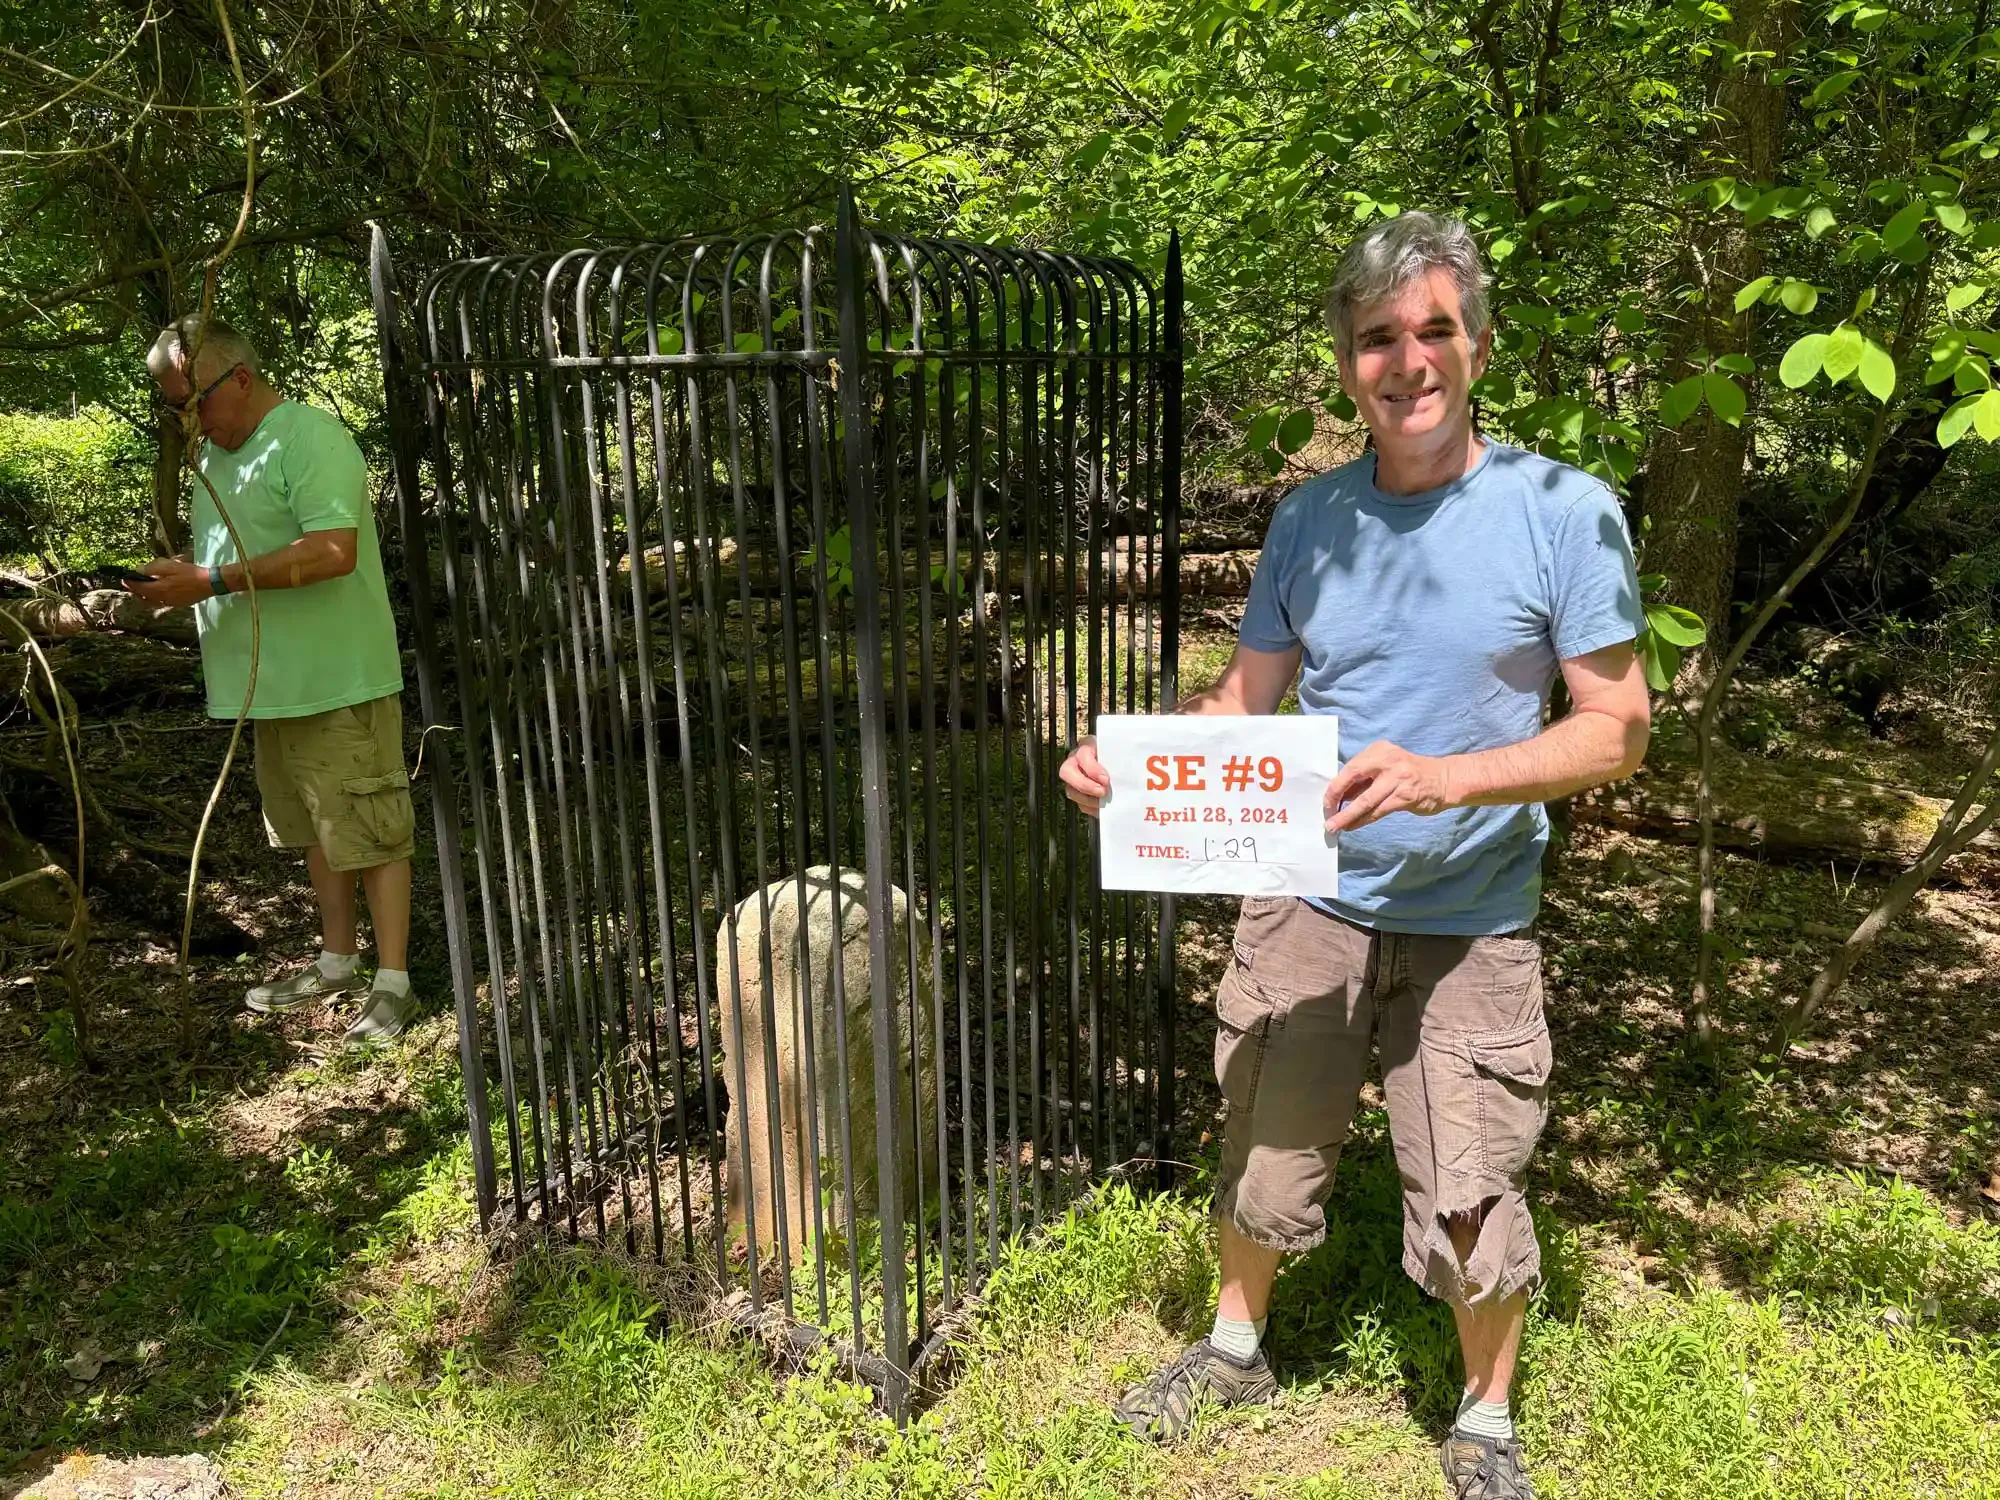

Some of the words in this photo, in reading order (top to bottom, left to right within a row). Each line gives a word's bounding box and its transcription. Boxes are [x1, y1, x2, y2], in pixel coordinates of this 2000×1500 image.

[1146, 755, 1206, 791] SE
[1221, 755, 1284, 793] #9
[1144, 807, 1197, 826] April
[1203, 807, 1233, 826] 28,
[1240, 808, 1288, 824] 2024
[1135, 845, 1190, 859] TIME:
[1204, 837, 1258, 863] 1:29
